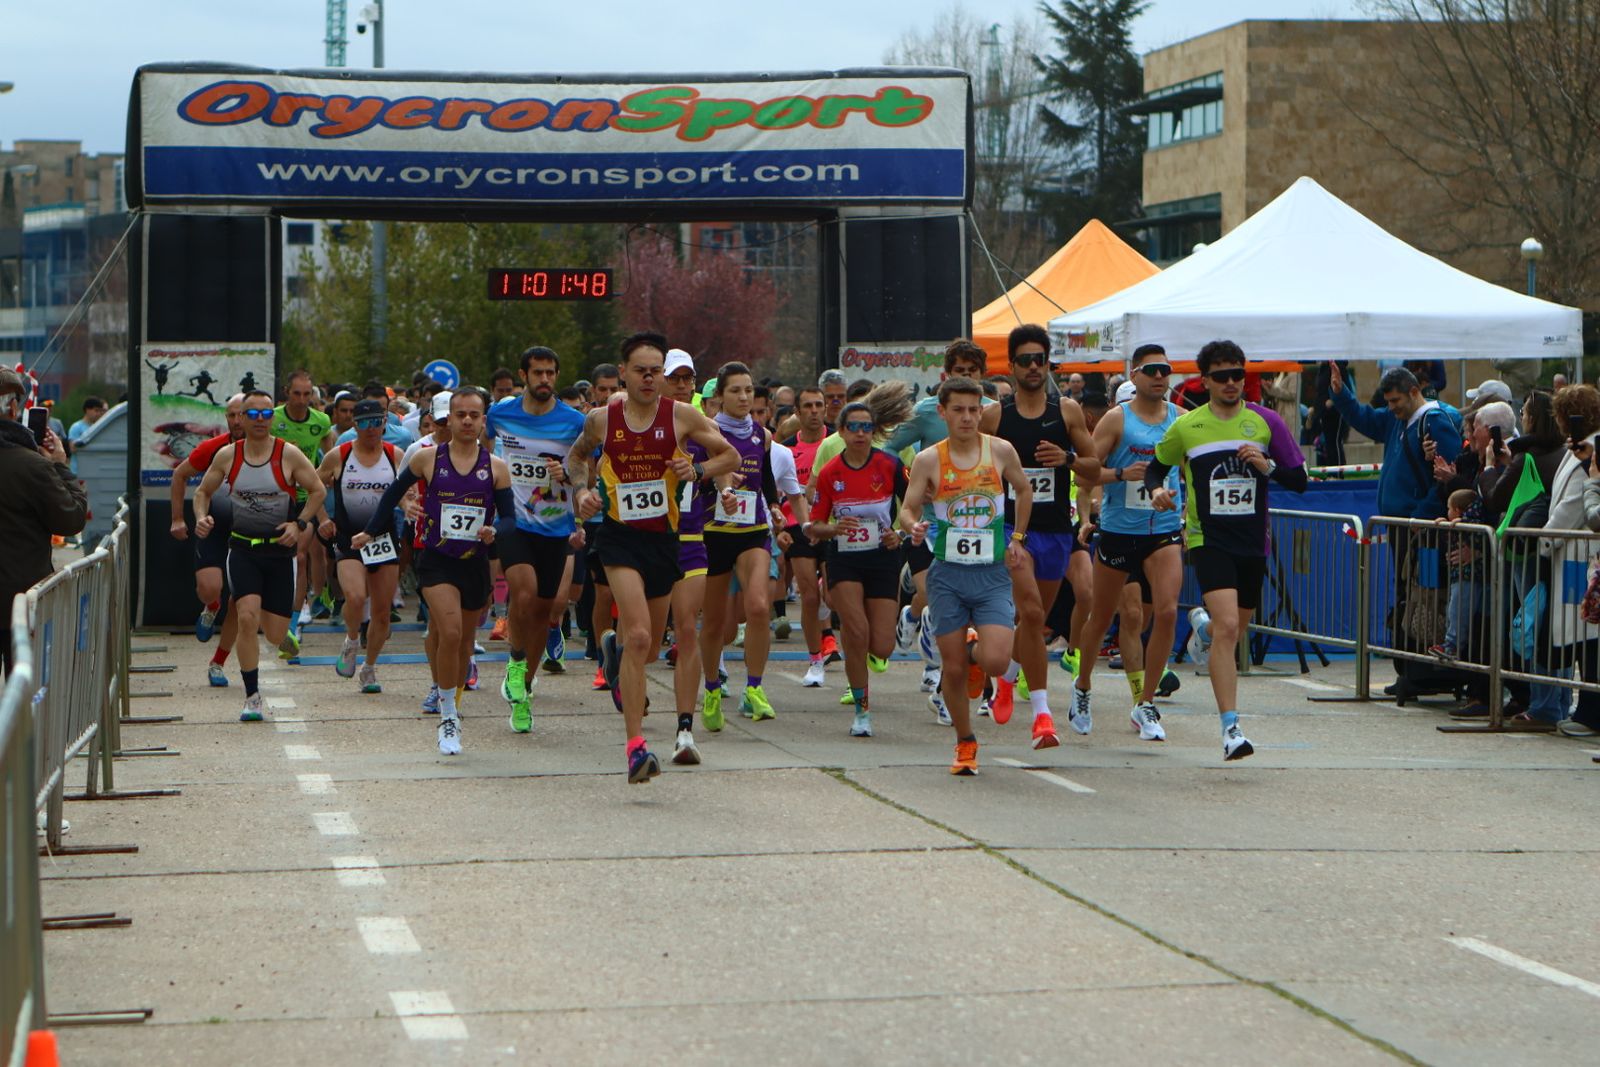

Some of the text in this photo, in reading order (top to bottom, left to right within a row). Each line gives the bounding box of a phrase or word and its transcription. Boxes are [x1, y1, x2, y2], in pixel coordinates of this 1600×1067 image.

[178, 80, 934, 142] OrycronSport
[257, 162, 861, 190] www.orycronsport.com
[842, 347, 945, 373] OrycronSpo
[511, 462, 547, 479] 339
[629, 463, 652, 472] VINO
[634, 471, 660, 480] TORO
[622, 490, 664, 511] 130
[1215, 488, 1254, 506] 154
[450, 514, 476, 531] 37
[847, 527, 870, 543] 23
[362, 541, 392, 558] 126
[956, 538, 982, 555] 61
